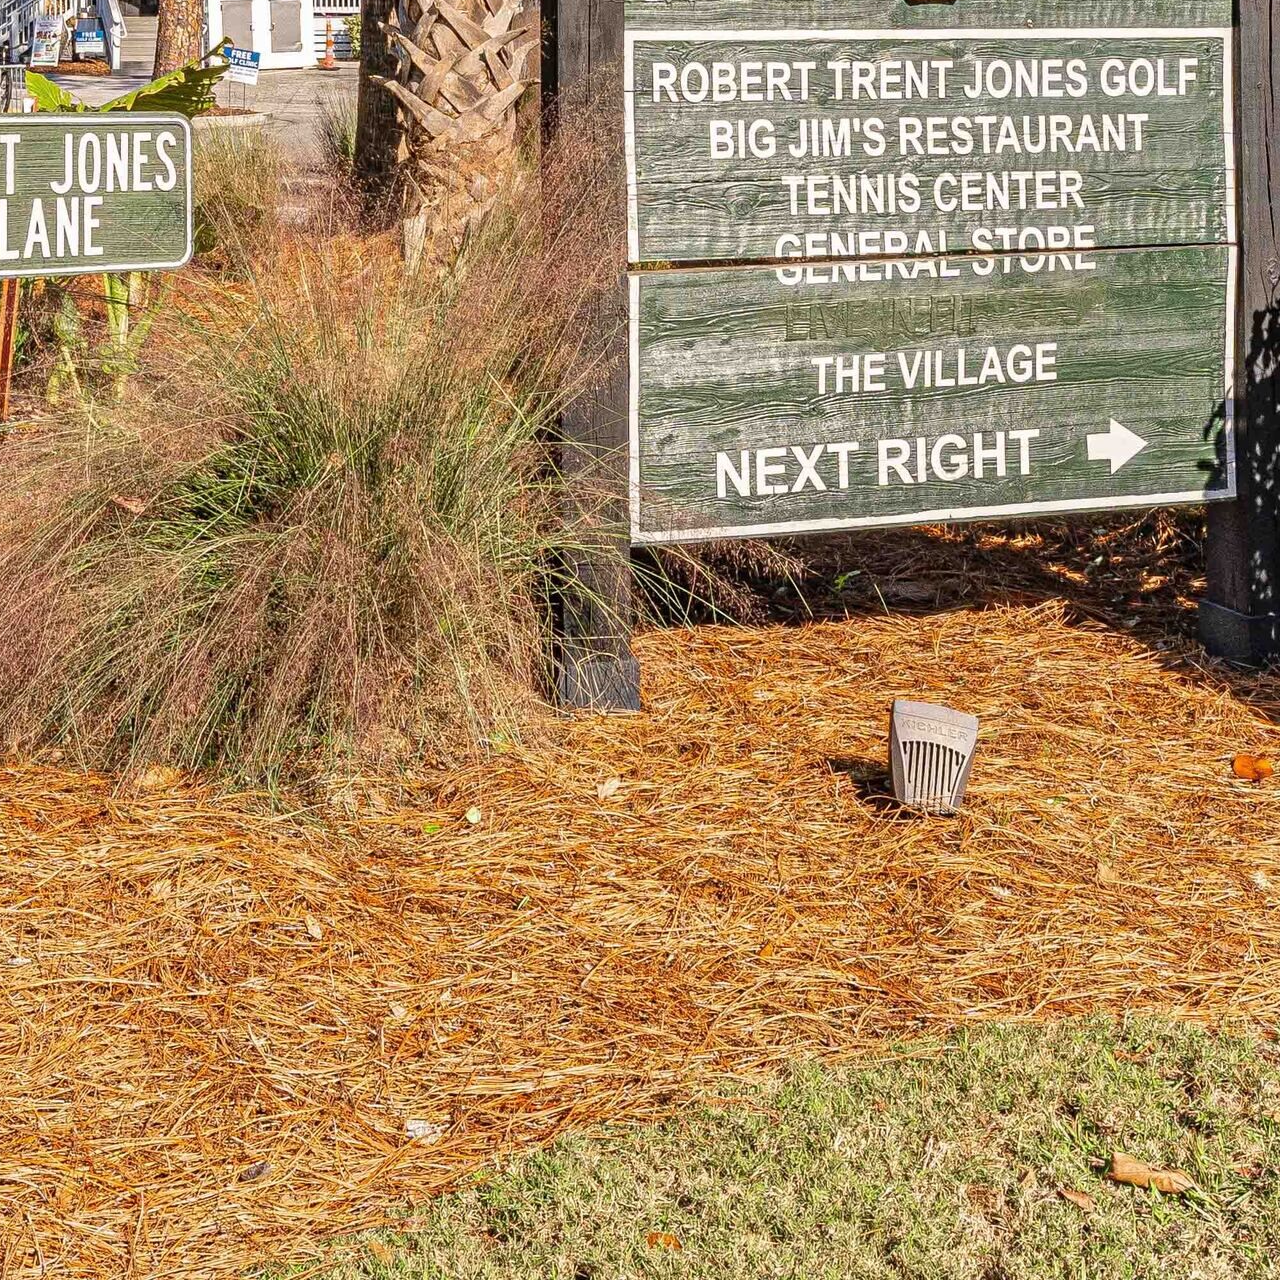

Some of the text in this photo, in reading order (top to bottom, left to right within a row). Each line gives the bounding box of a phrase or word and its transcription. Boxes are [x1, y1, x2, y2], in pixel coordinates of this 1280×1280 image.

[231, 50, 252, 60] FREE
[239, 59, 258, 68] CLINIC
[652, 57, 1199, 103] ROBERT TRENT JONES GOLF
[709, 113, 1149, 160] BIG JIM'S RESTAURANT
[49, 131, 177, 195] JONES
[781, 170, 1085, 216] TENNIS CENTER
[774, 225, 1097, 286] GENERAL STORE
[811, 342, 1058, 395] THE VILLAGE
[715, 428, 1040, 499] NEXT RIGHT
